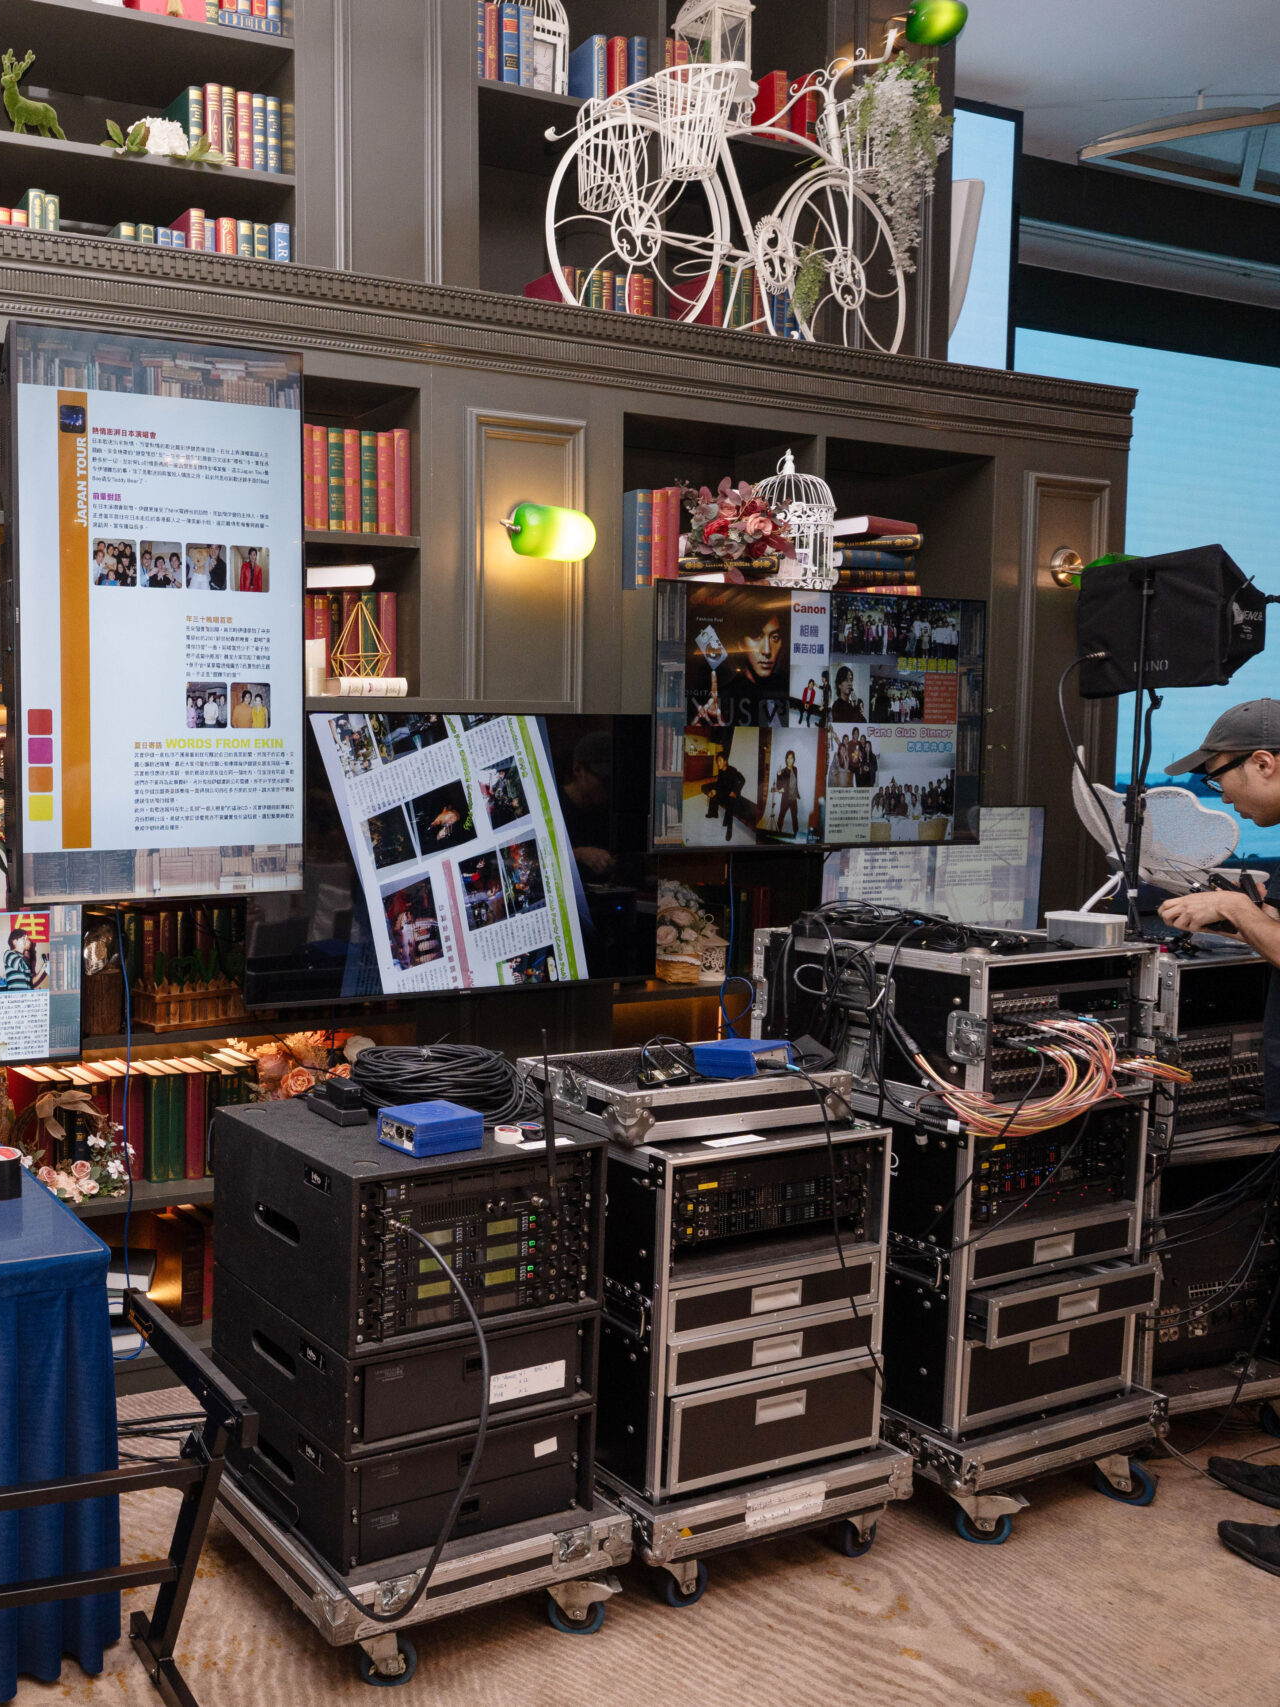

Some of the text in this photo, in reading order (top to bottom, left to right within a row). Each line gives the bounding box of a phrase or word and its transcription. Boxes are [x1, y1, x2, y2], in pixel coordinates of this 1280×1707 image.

[76, 437, 88, 528] JAPAN TOUR
[793, 602, 826, 614] Canon
[867, 727, 892, 737] Fans
[896, 727, 918, 738] Club
[165, 738, 284, 749] WORDS FROM EKIN
